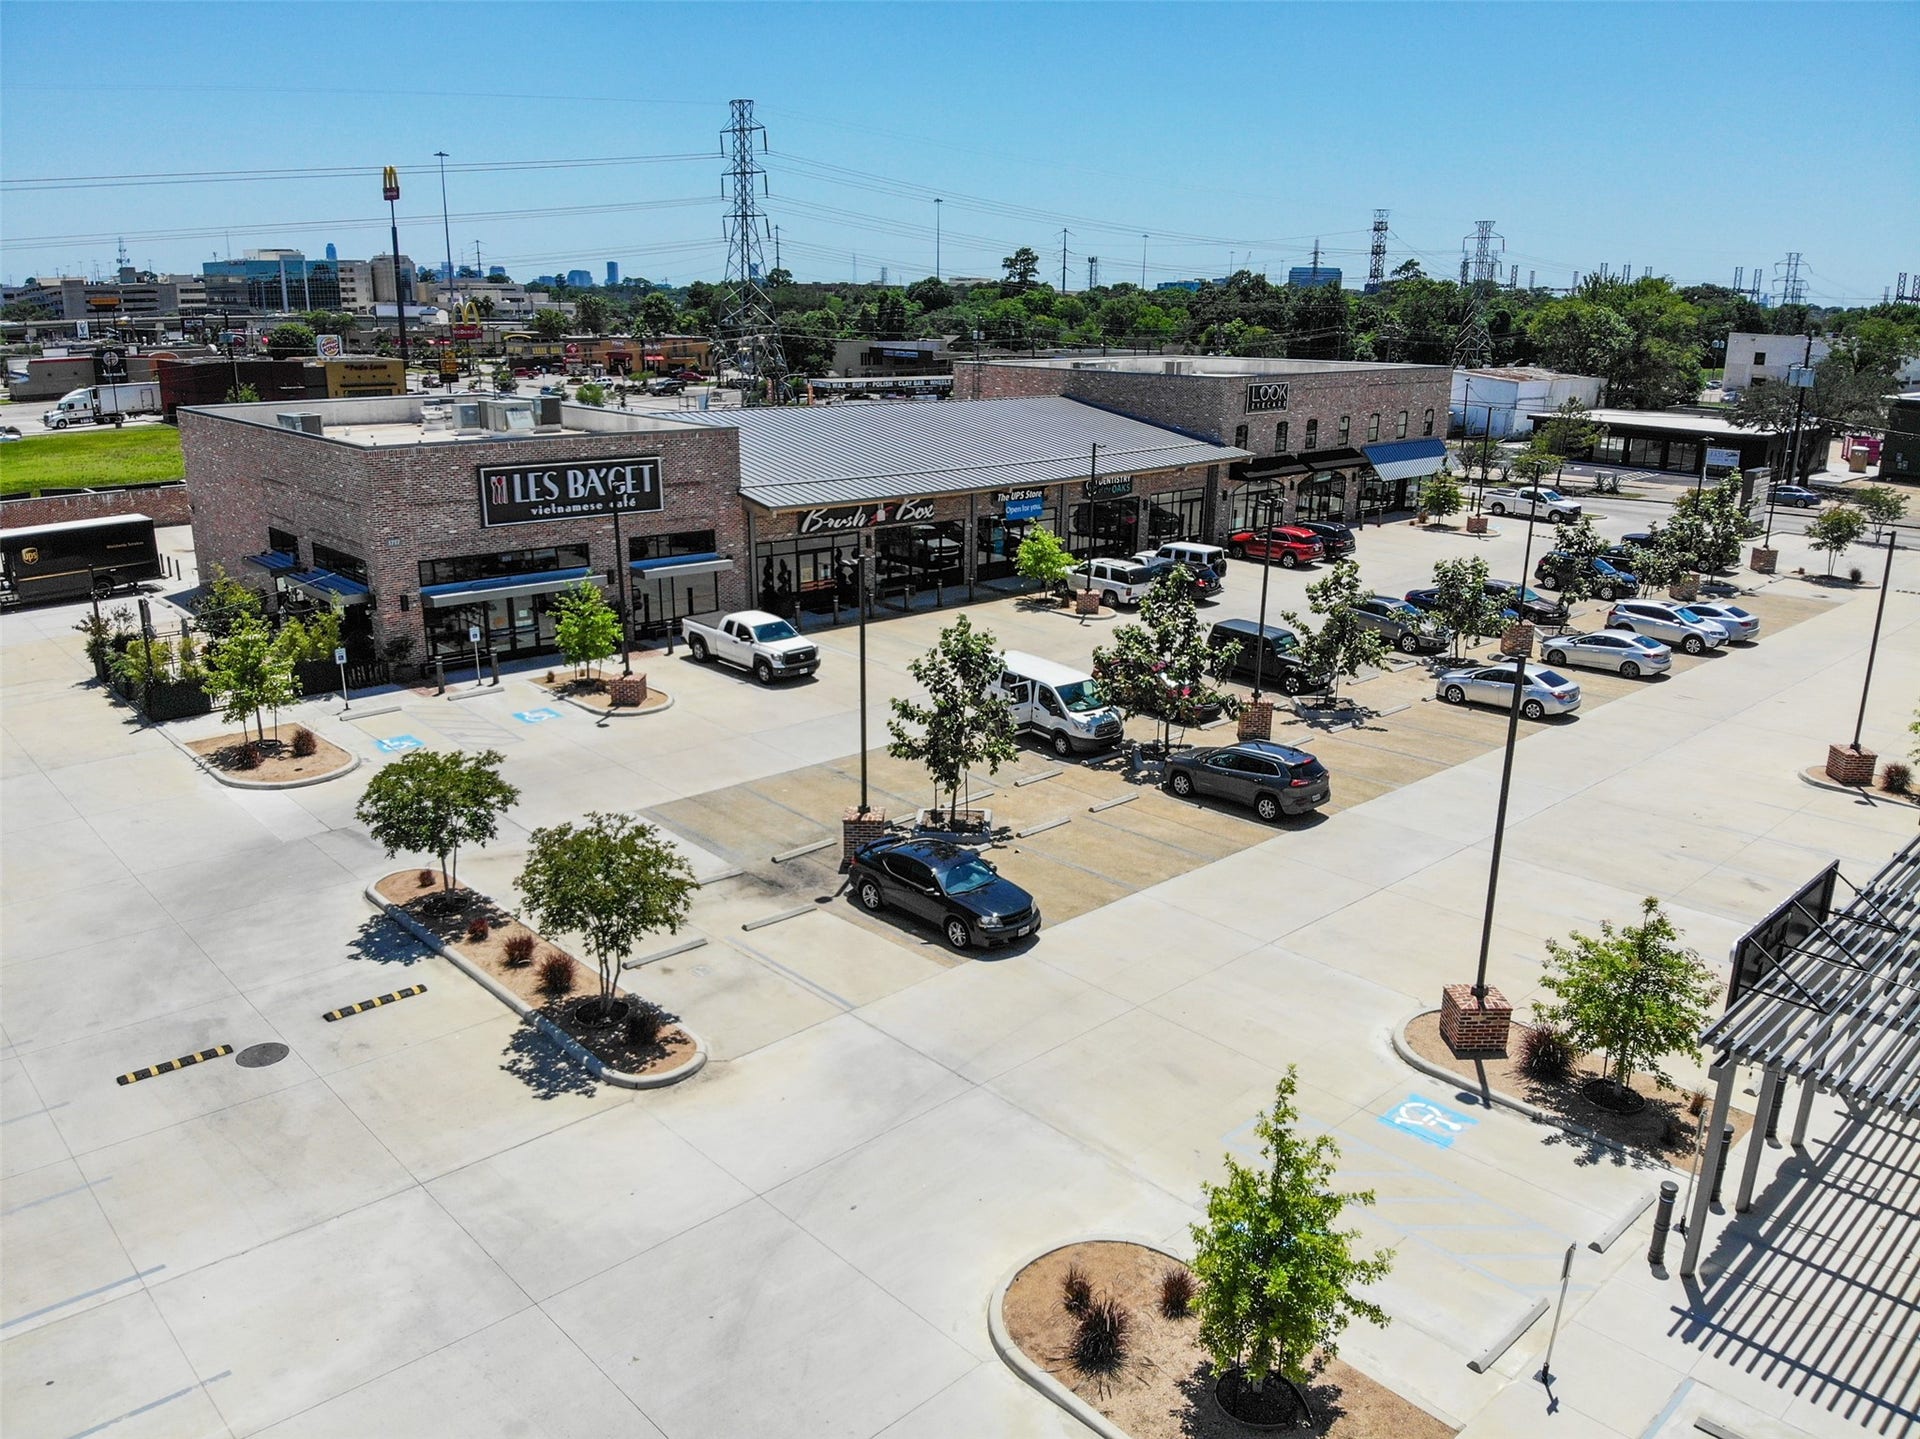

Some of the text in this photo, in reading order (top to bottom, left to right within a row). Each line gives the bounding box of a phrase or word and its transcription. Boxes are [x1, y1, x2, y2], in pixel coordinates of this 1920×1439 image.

[1252, 384, 1287, 402] LOOK
[1251, 400, 1286, 410] EYECARE
[512, 471, 560, 503] LES
[1111, 482, 1131, 494] OAKS
[997, 489, 1043, 502] The UPS Store
[530, 501, 603, 516] vietnamese
[1005, 506, 1022, 515] Open
[1021, 504, 1030, 512] for
[801, 498, 935, 533] Brush Box
[23, 551, 39, 564] ups
